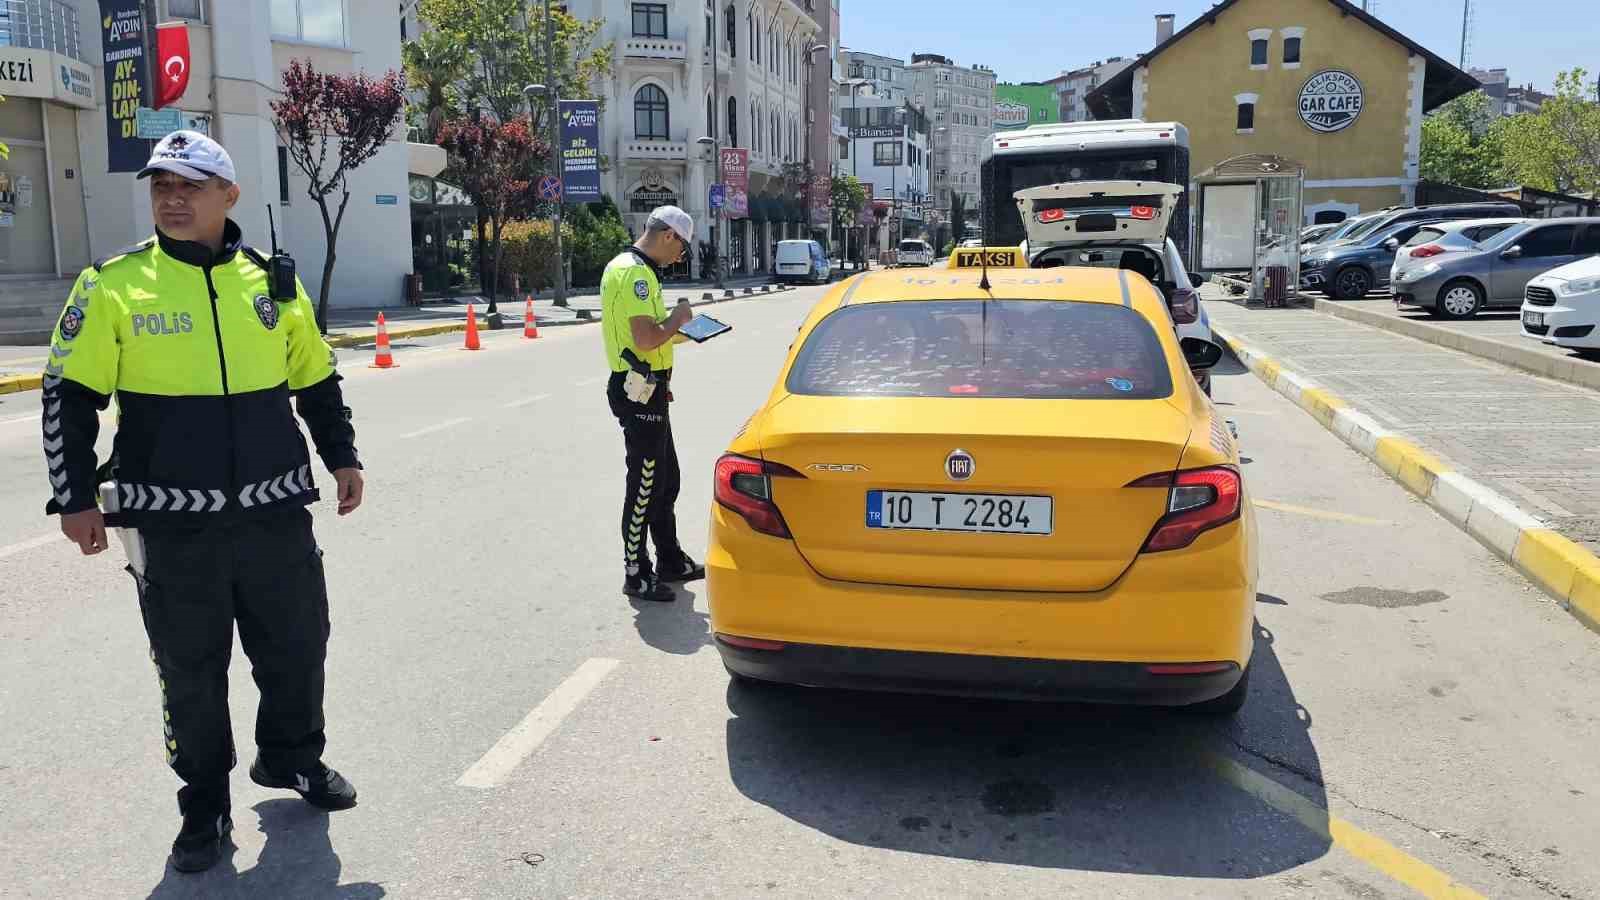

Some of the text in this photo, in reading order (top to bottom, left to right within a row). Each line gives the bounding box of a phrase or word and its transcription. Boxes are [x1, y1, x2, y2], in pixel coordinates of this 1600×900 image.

[110, 17, 141, 42] AYDIN
[105, 46, 142, 62] BANDIRMA
[1300, 95, 1360, 111] GAR CAFE
[568, 115, 596, 127] AYDIN
[860, 127, 893, 137] Bianca
[723, 152, 740, 165] 23
[951, 459, 969, 473] FIAT
[869, 511, 881, 520] TR
[886, 495, 1031, 528] 10 T 2284
